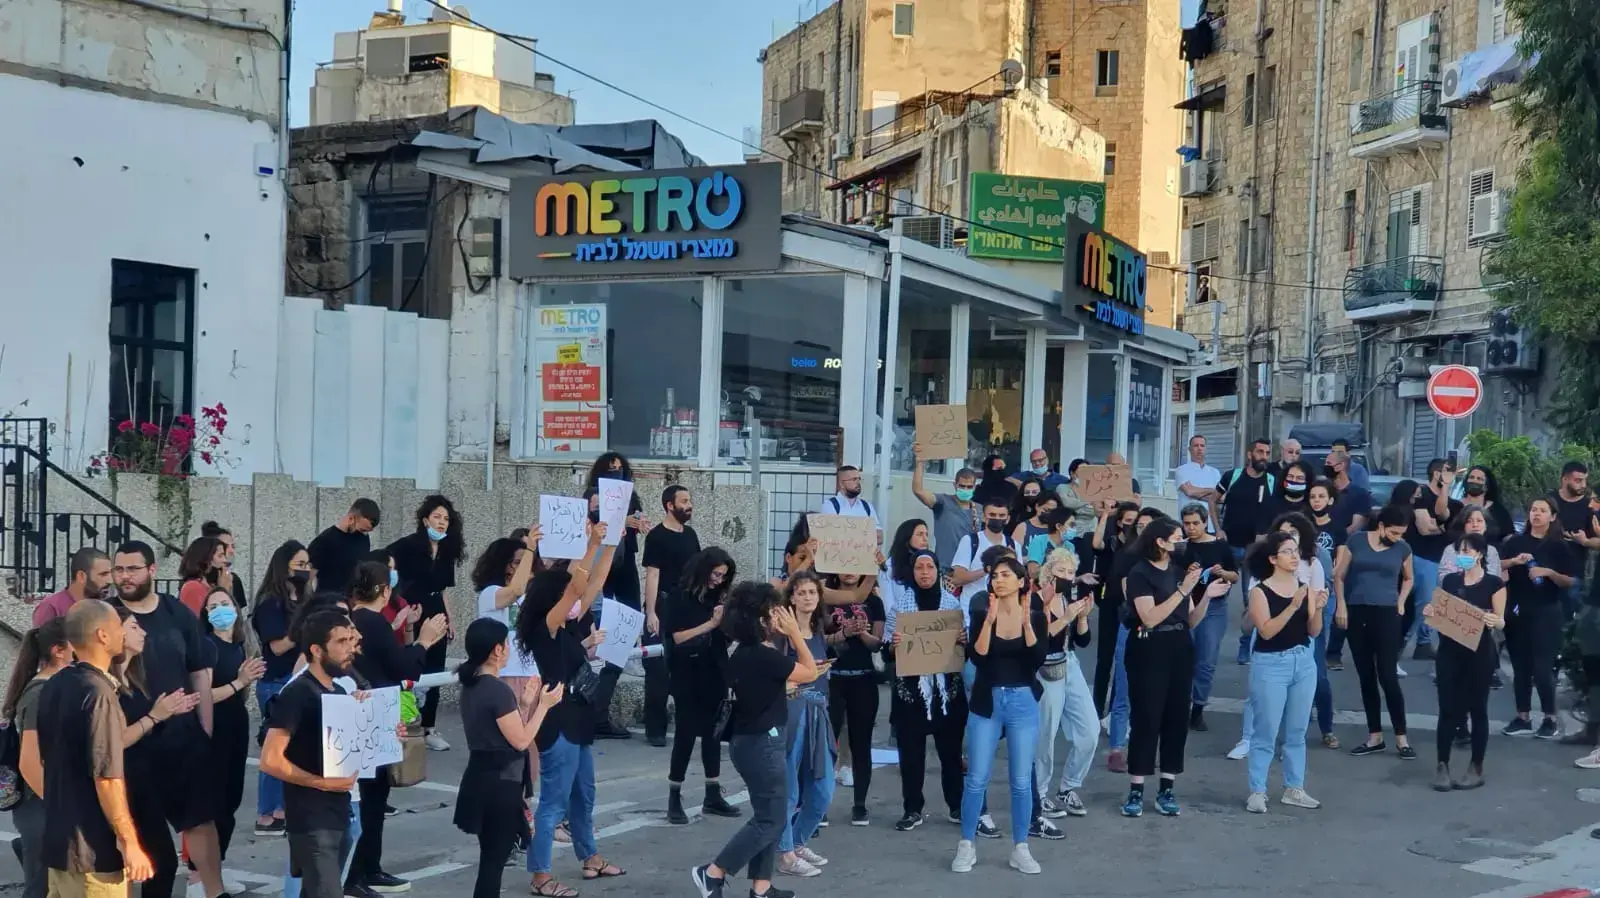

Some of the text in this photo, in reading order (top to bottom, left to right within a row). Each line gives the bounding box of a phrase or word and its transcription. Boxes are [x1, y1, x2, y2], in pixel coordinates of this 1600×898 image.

[992, 178, 1060, 202] حلويات
[536, 171, 742, 236] METRO
[576, 236, 734, 262] מוצרי חשמל לבית
[1083, 231, 1146, 309] METRO
[541, 305, 600, 325] METRO
[791, 357, 818, 368] beko
